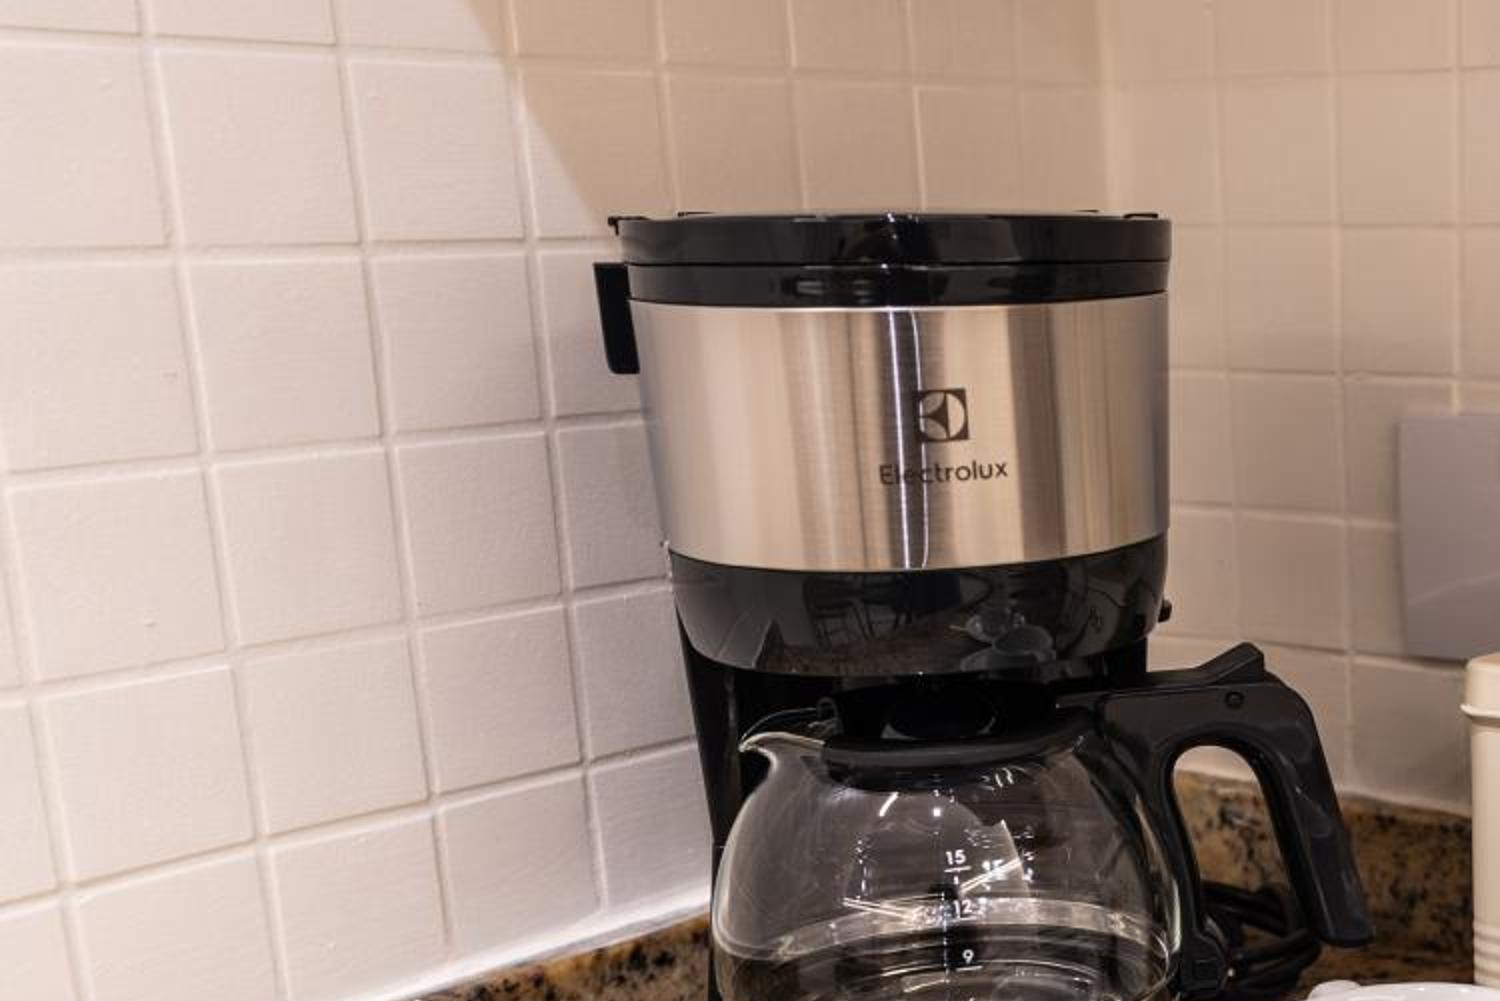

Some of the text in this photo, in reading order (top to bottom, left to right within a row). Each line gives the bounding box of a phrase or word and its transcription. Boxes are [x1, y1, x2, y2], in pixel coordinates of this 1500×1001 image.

[879, 460, 1008, 486] Electrolux
[945, 849, 967, 866] 15
[962, 948, 975, 964] 9
